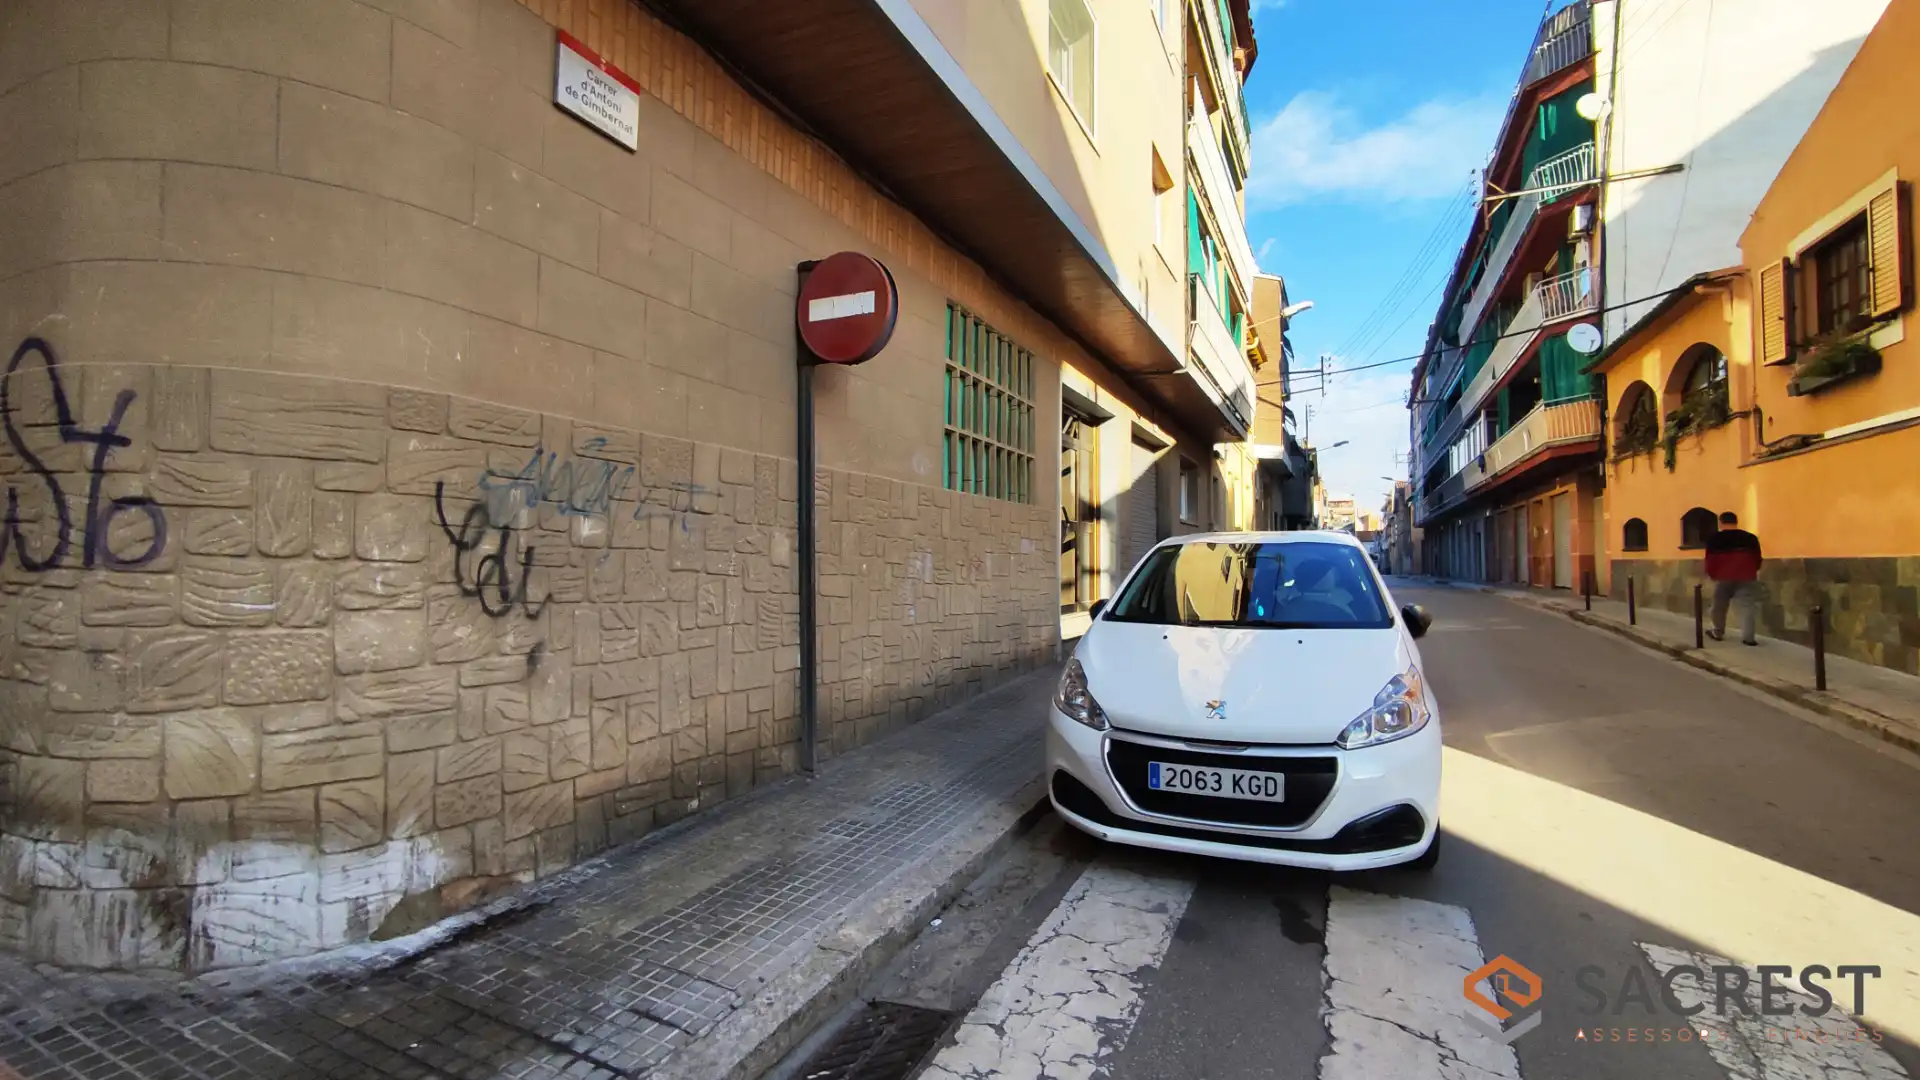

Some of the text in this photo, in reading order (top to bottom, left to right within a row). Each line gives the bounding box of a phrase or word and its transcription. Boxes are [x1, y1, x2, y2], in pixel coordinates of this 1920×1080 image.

[581, 81, 621, 113] d'Antoni
[586, 69, 618, 97] Carrer
[565, 85, 579, 99] de
[581, 94, 634, 135] Gimbernat
[1165, 767, 1278, 797] 2063 KGD
